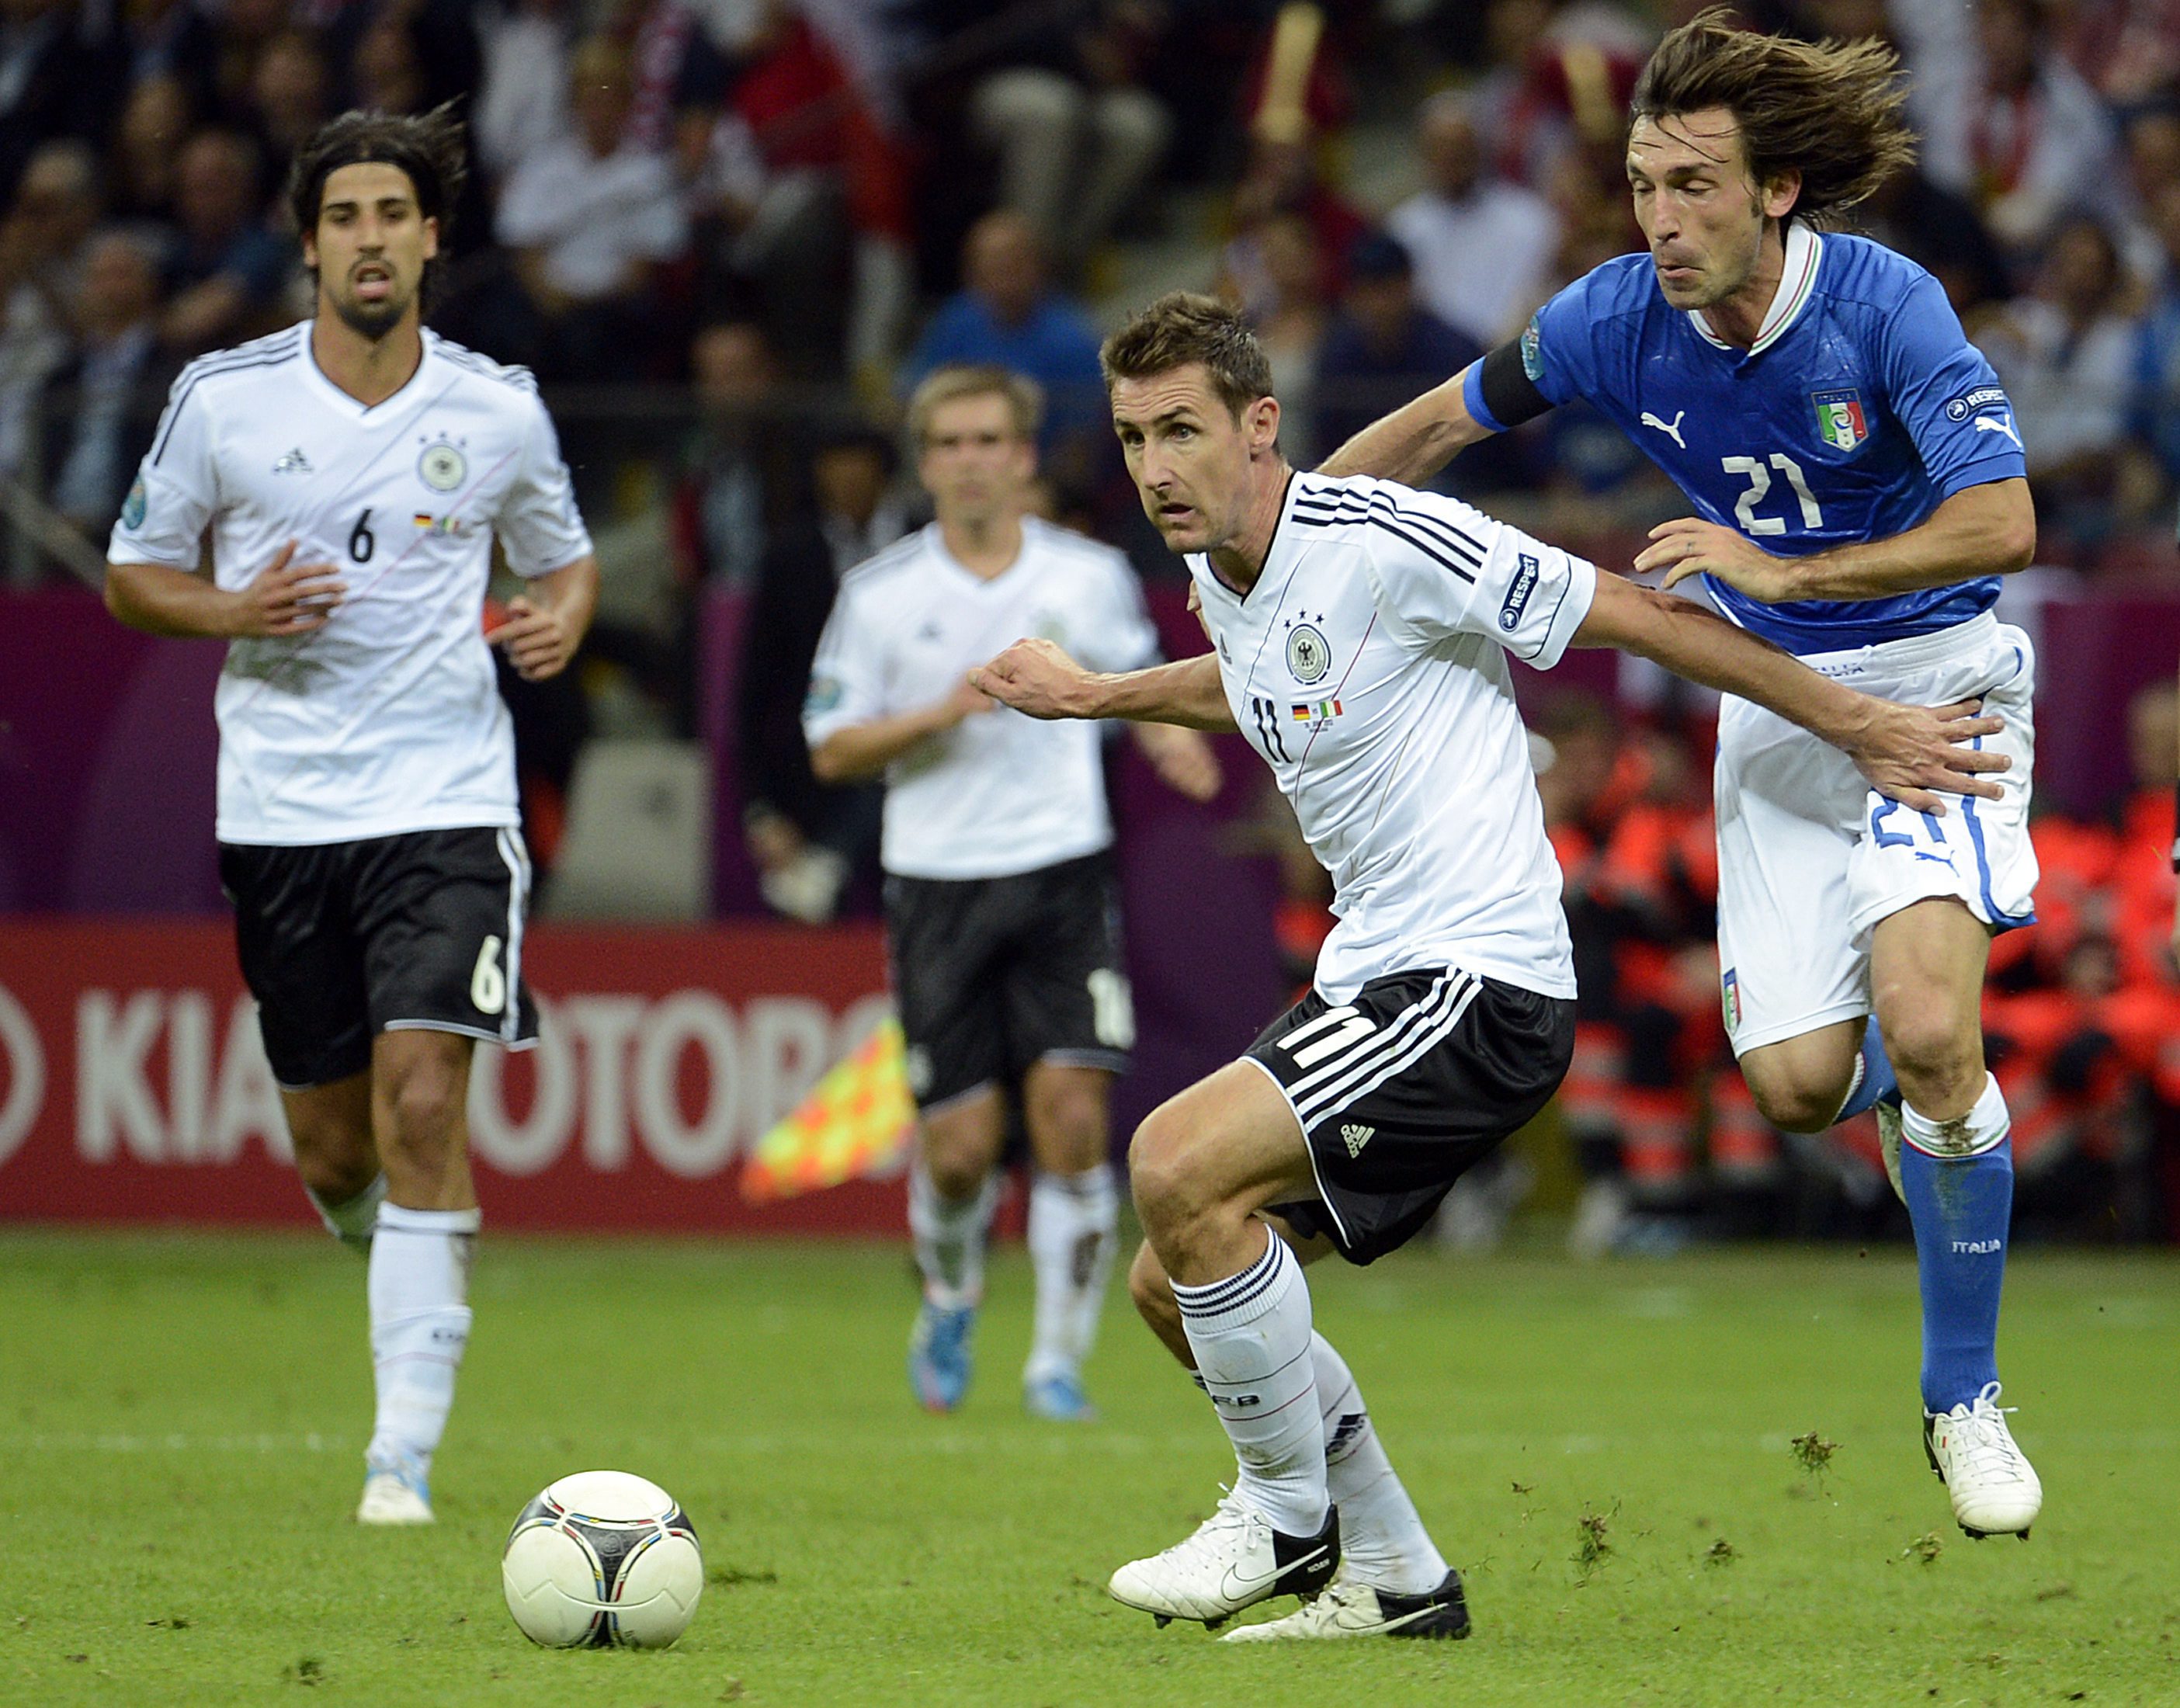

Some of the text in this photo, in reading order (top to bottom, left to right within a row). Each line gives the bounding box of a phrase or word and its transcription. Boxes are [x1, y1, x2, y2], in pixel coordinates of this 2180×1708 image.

[1721, 452, 1824, 536] 21
[349, 508, 375, 564] 6
[1508, 555, 1537, 609] RESPECT
[1252, 696, 1294, 765] 11
[470, 934, 505, 1015] 6
[1276, 1005, 1378, 1071] 11
[75, 986, 913, 1182] KIA OTOR
[1340, 1123, 1360, 1159] adidas
[1952, 1238, 2001, 1255] ITALIA
